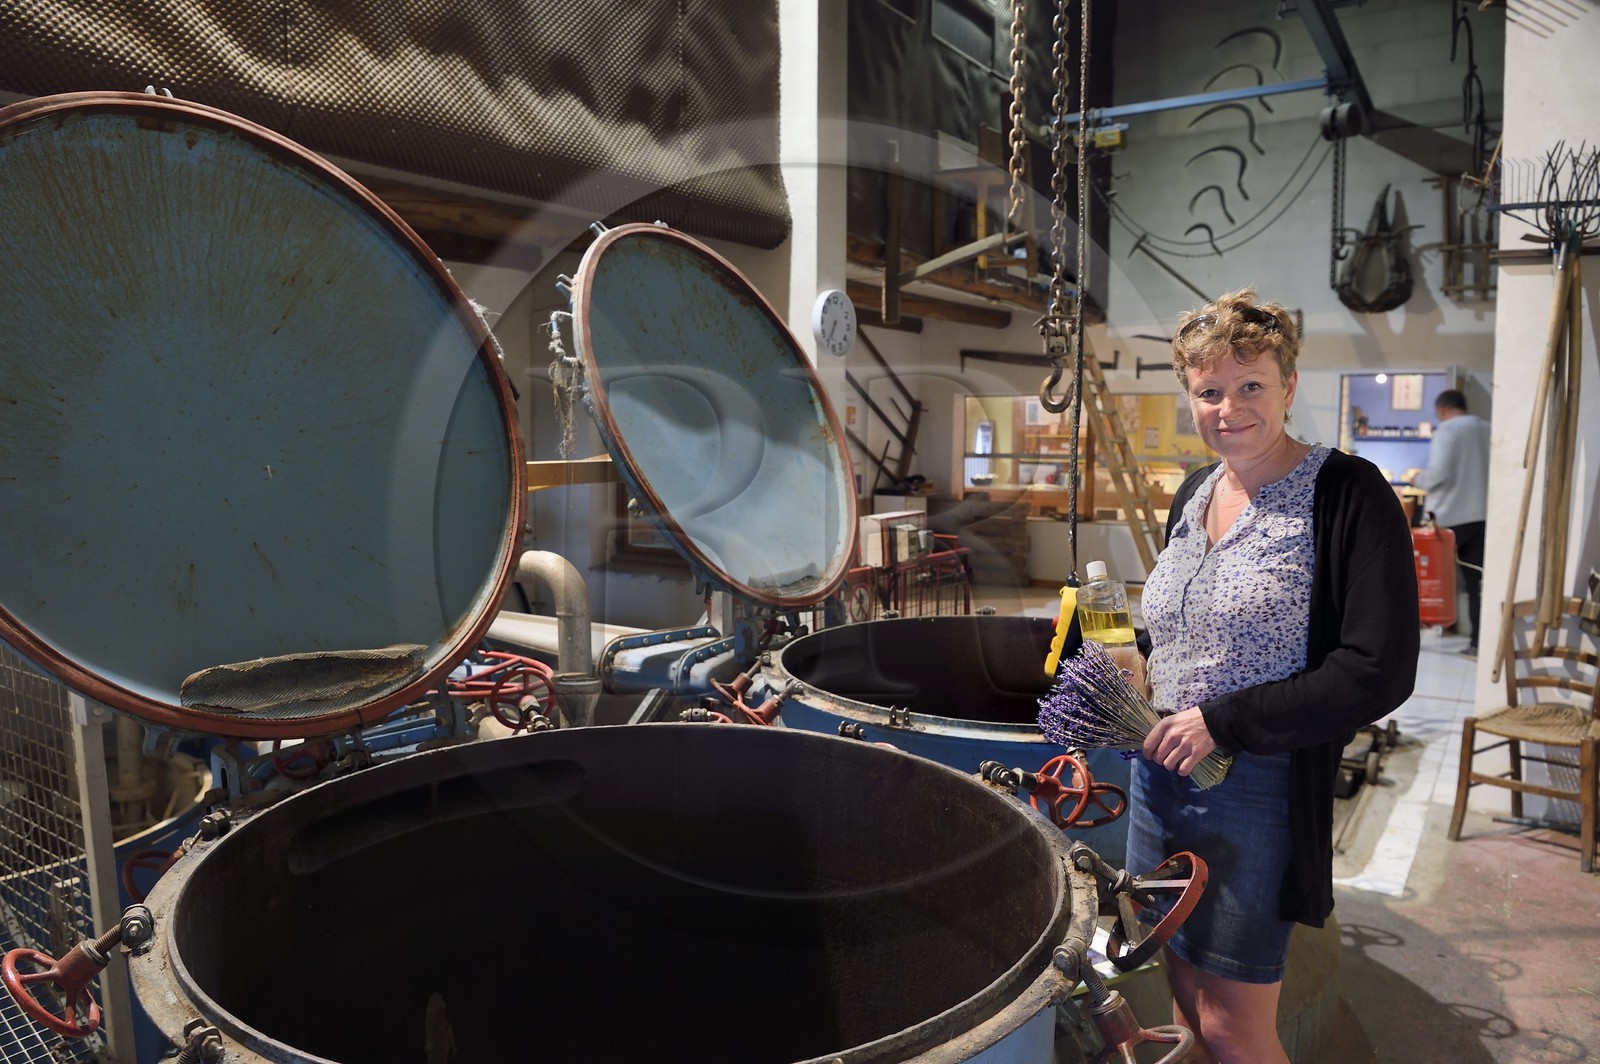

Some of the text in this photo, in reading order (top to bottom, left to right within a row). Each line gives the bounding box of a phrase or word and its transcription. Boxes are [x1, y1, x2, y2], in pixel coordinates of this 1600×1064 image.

[832, 296, 839, 305] 12
[844, 311, 849, 320] 2
[831, 344, 836, 353] 6
